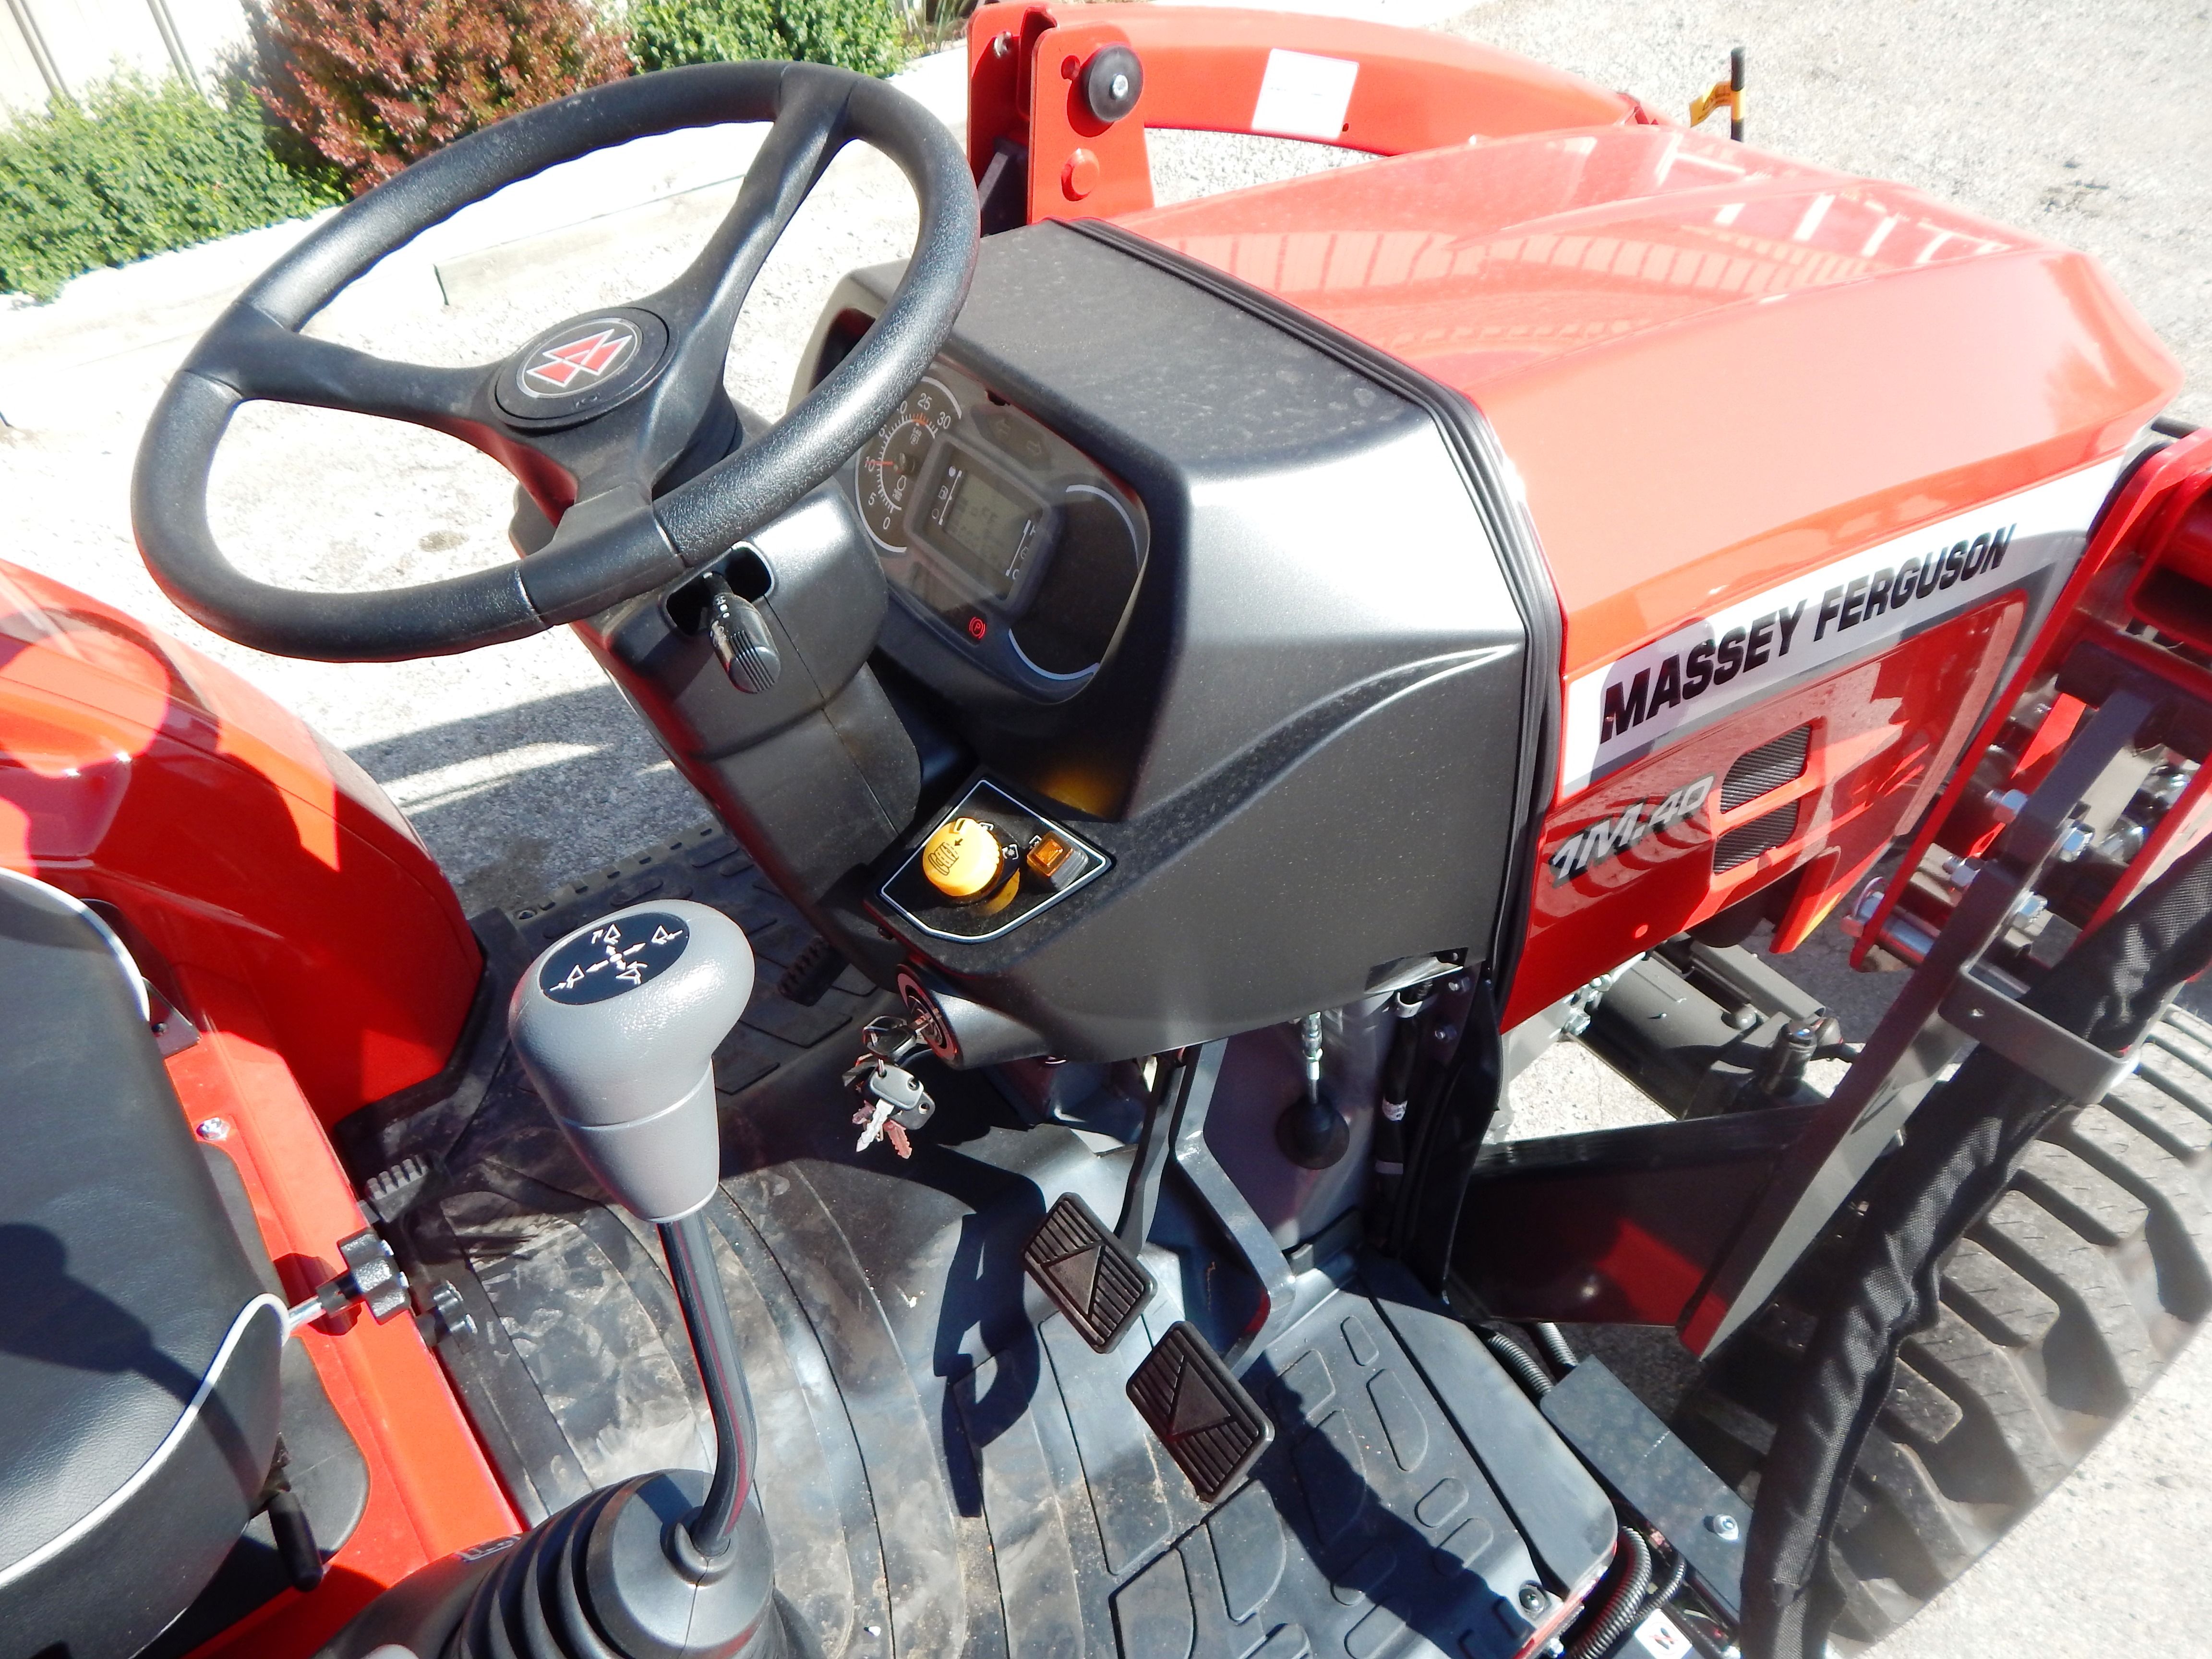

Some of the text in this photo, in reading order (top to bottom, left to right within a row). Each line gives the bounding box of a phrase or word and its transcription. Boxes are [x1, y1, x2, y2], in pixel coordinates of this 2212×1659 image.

[896, 400, 908, 414] 0
[917, 393, 932, 410] 25
[937, 411, 951, 429] 30
[865, 456, 875, 472] 10
[868, 492, 877, 505] 5
[883, 517, 890, 529] 0
[1600, 523, 2017, 744] MASSEY FERGUSON
